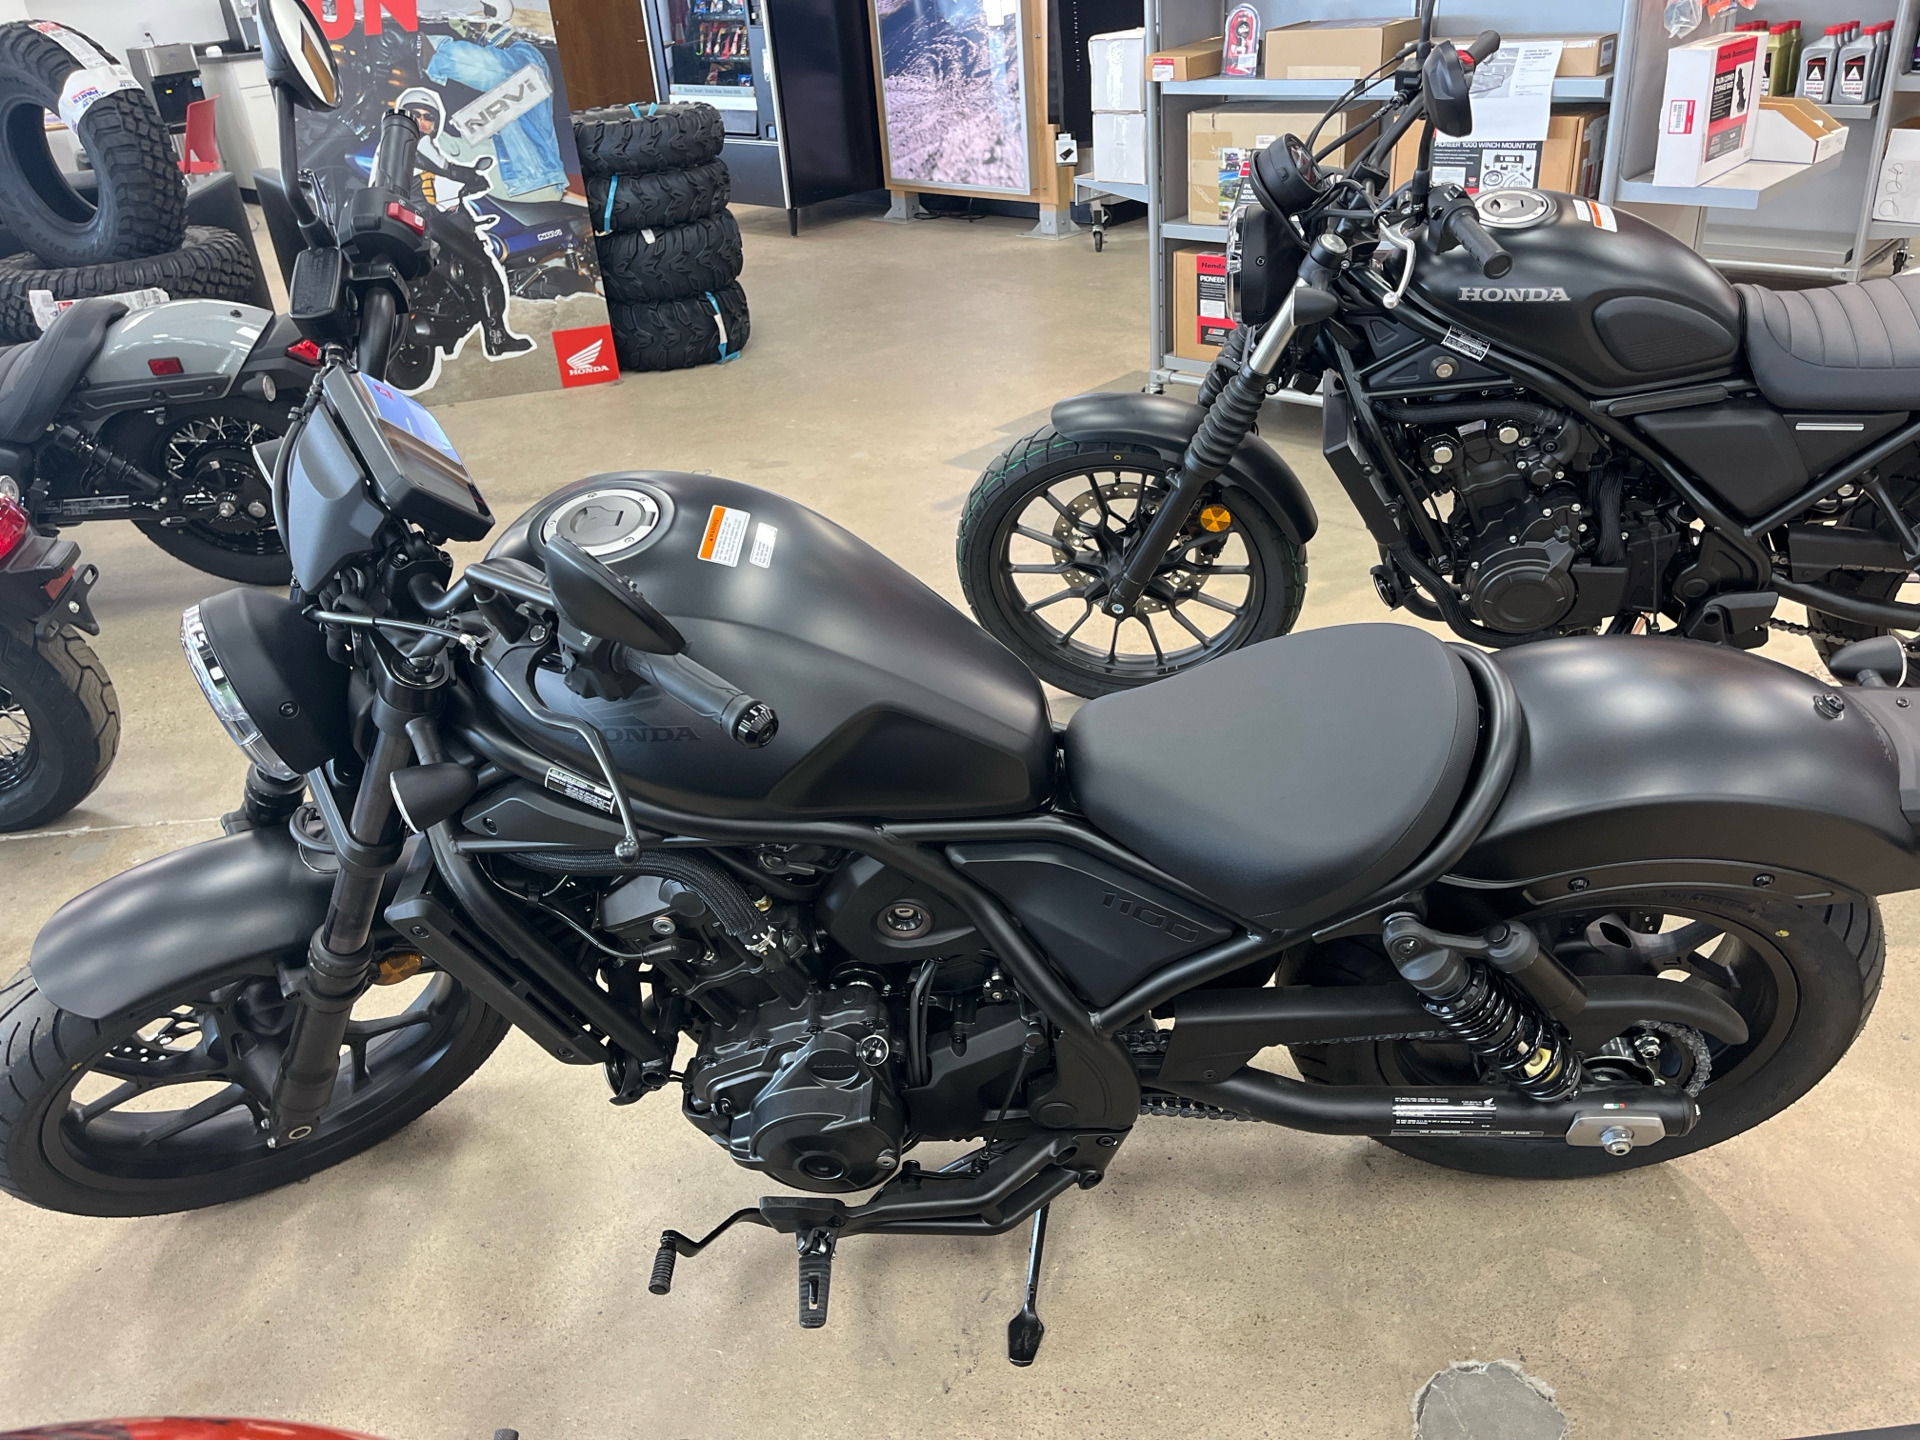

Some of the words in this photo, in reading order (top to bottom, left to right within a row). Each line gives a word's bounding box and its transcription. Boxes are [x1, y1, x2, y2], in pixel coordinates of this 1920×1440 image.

[1200, 275, 1226, 283] PIONEER
[1458, 287, 1571, 302] HONDA
[568, 364, 610, 377] HONDA
[1102, 890, 1199, 943] 1100
